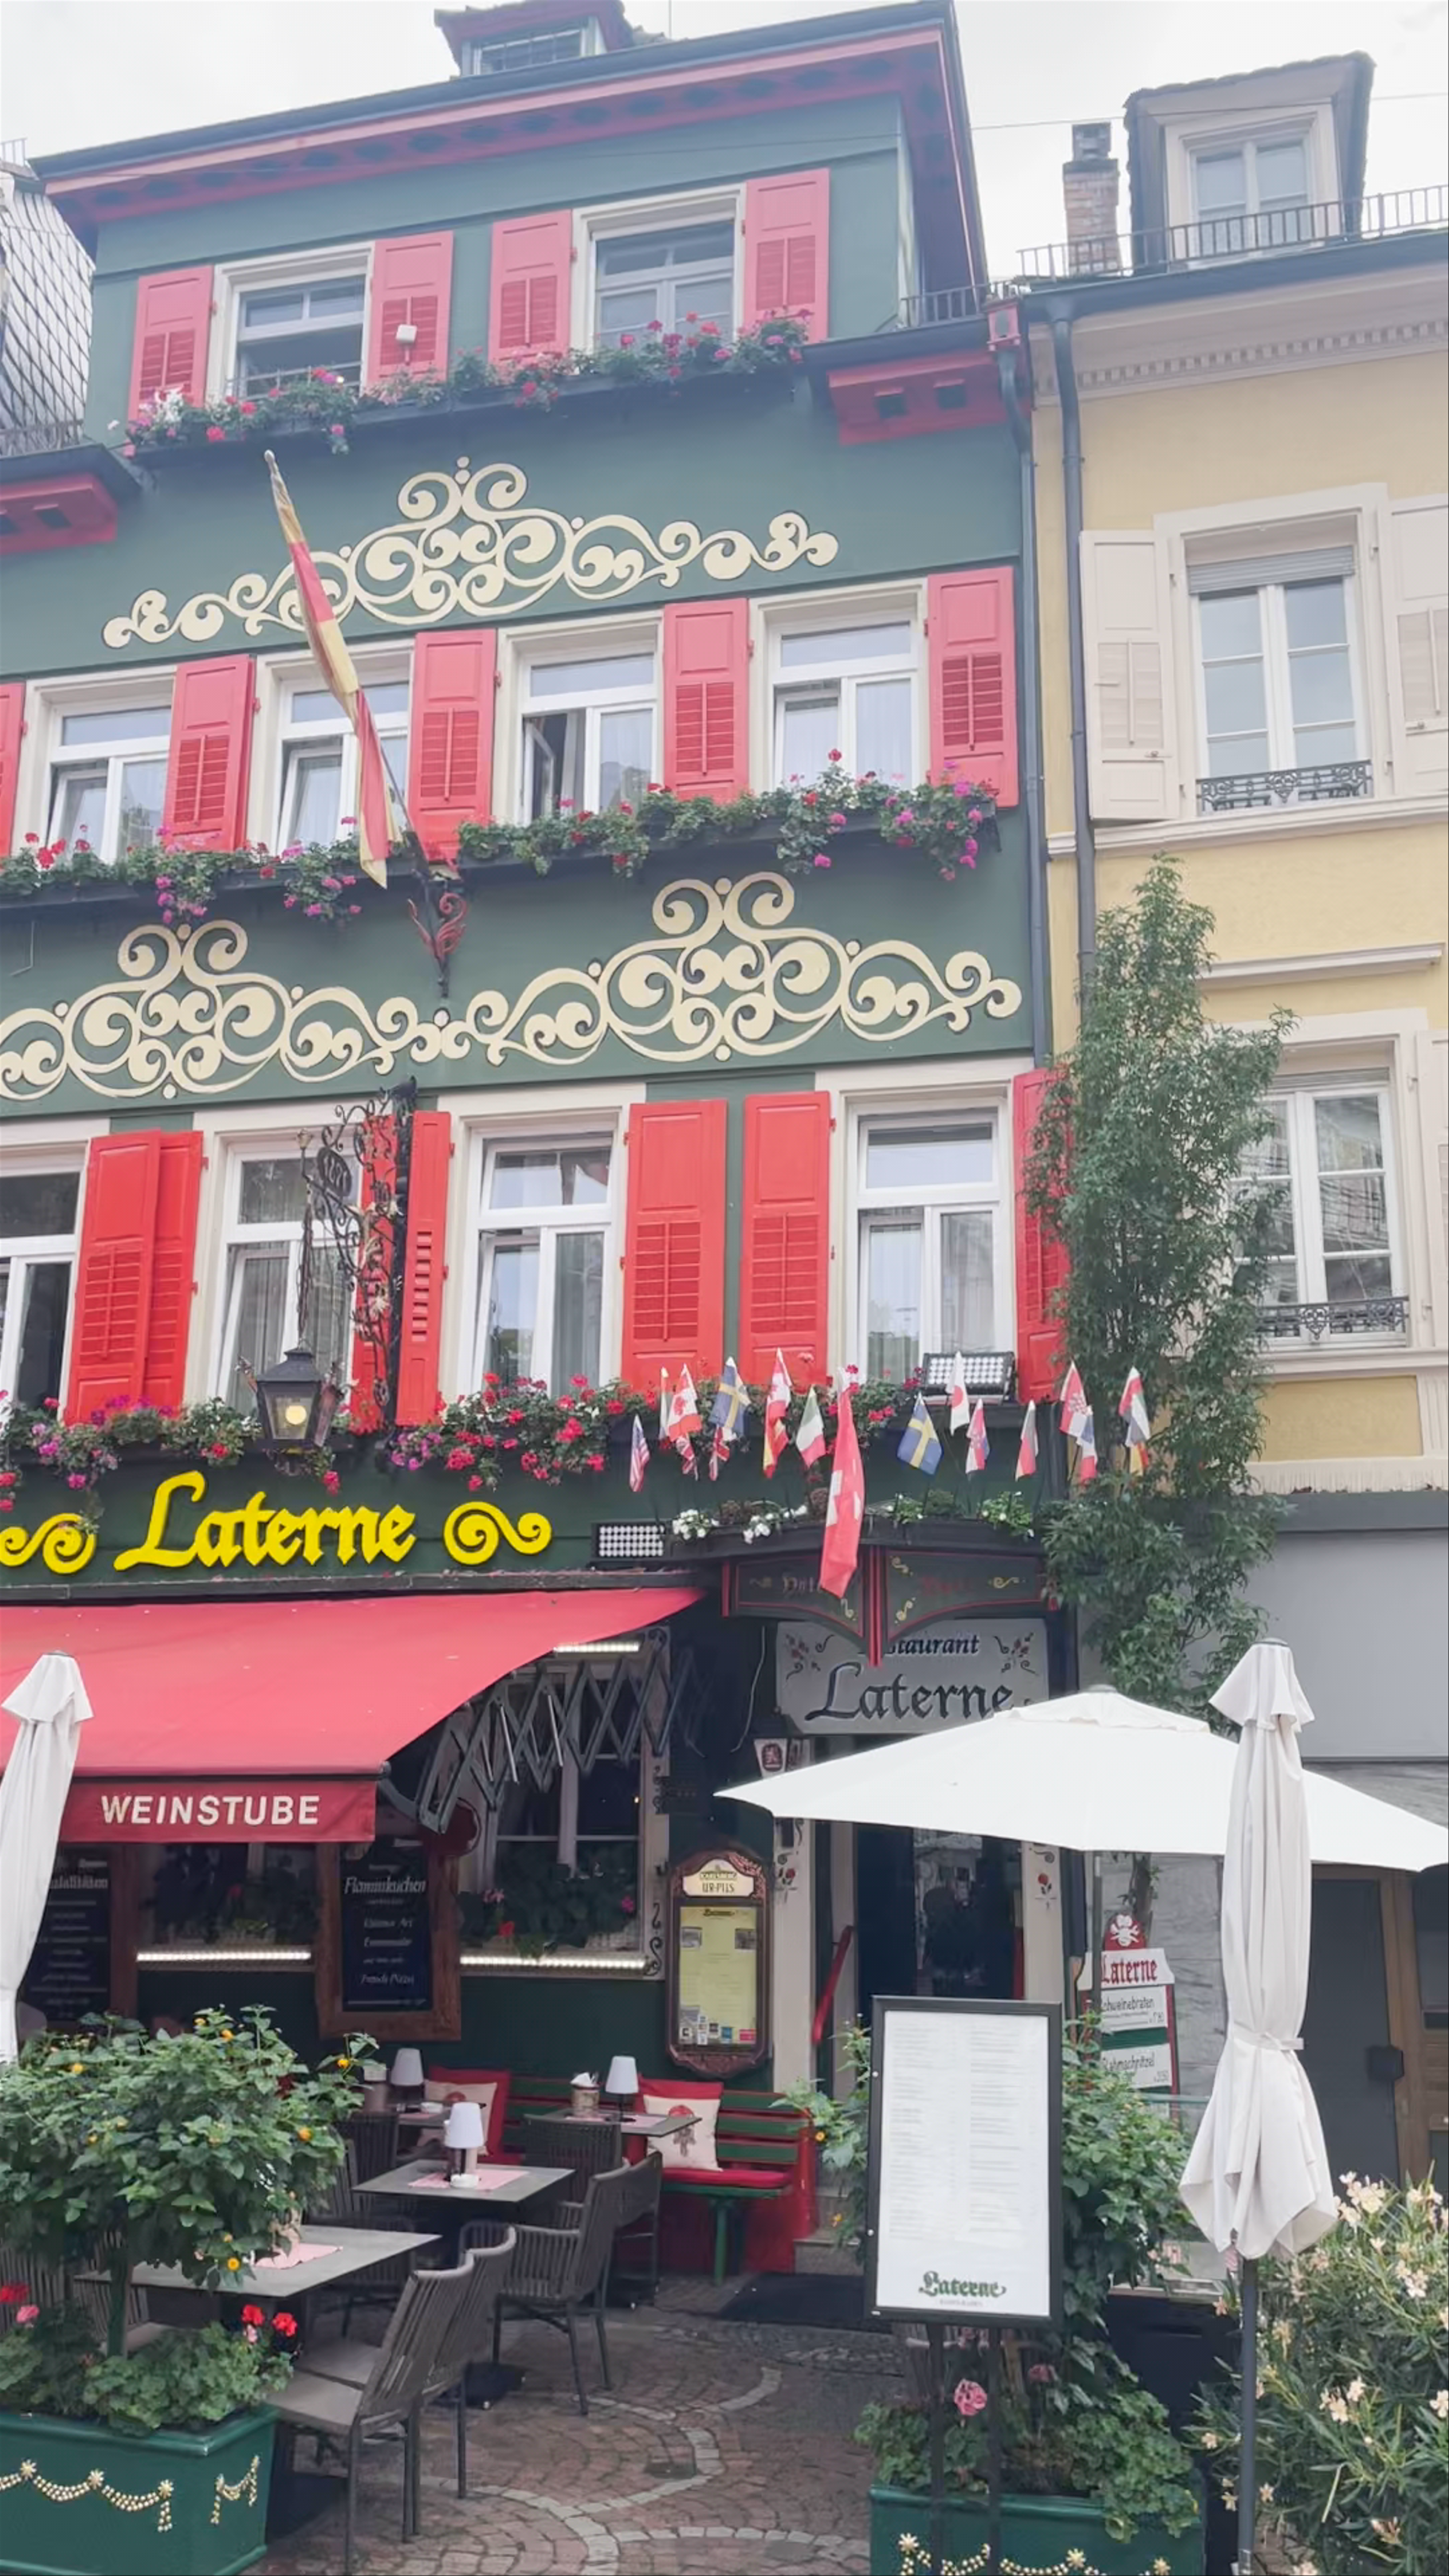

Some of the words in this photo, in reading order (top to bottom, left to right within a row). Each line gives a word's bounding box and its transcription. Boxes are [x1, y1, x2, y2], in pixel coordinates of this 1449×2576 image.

[114, 1470, 417, 1571] Laterne
[805, 1661, 1014, 1720] Laterne
[101, 1795, 321, 1825] WEINSTUBE
[1101, 1954, 1158, 1984] Laterne
[918, 2270, 1007, 2298] Laterne
